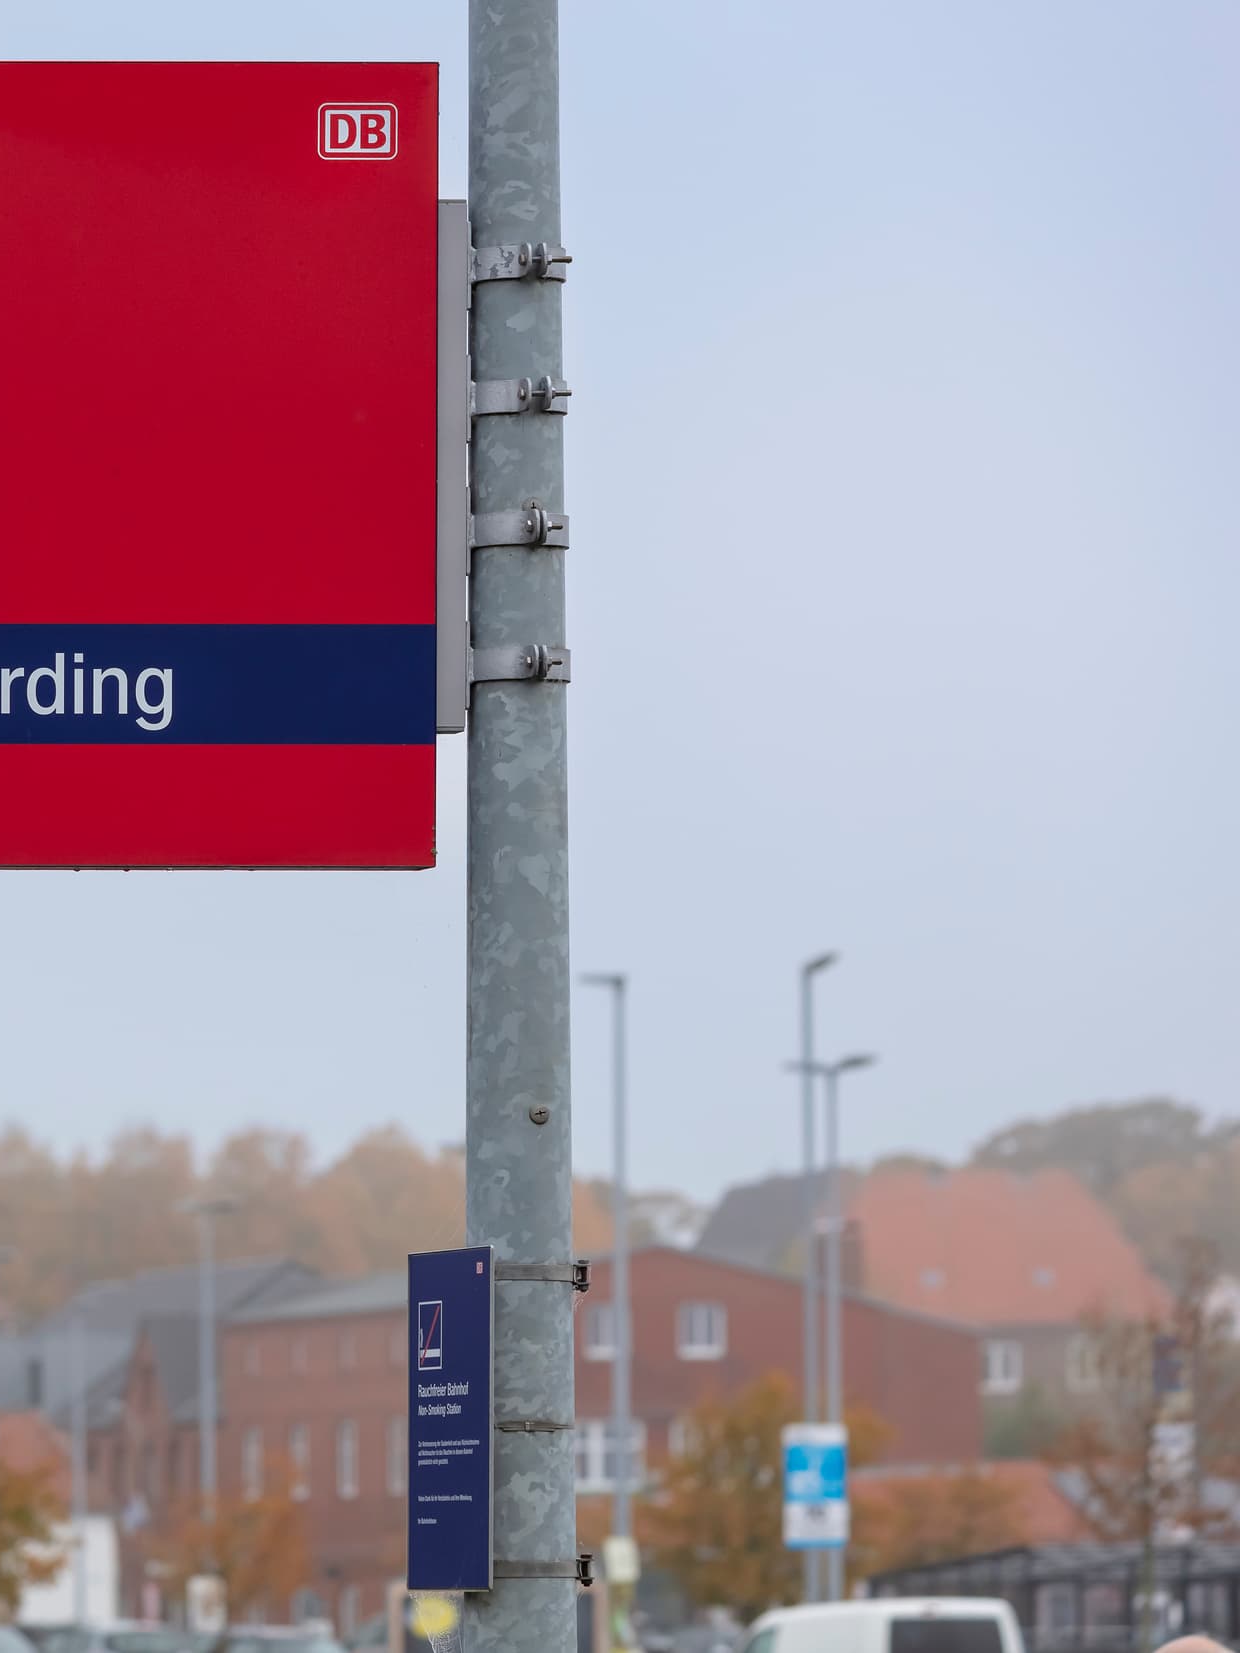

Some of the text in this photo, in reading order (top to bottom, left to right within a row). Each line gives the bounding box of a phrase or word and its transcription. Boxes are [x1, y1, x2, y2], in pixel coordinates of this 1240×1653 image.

[329, 113, 387, 149] DB
[417, 1380, 469, 1398] Rauchfreier Bahnhof
[417, 1403, 462, 1418] Non-Smoking Station
